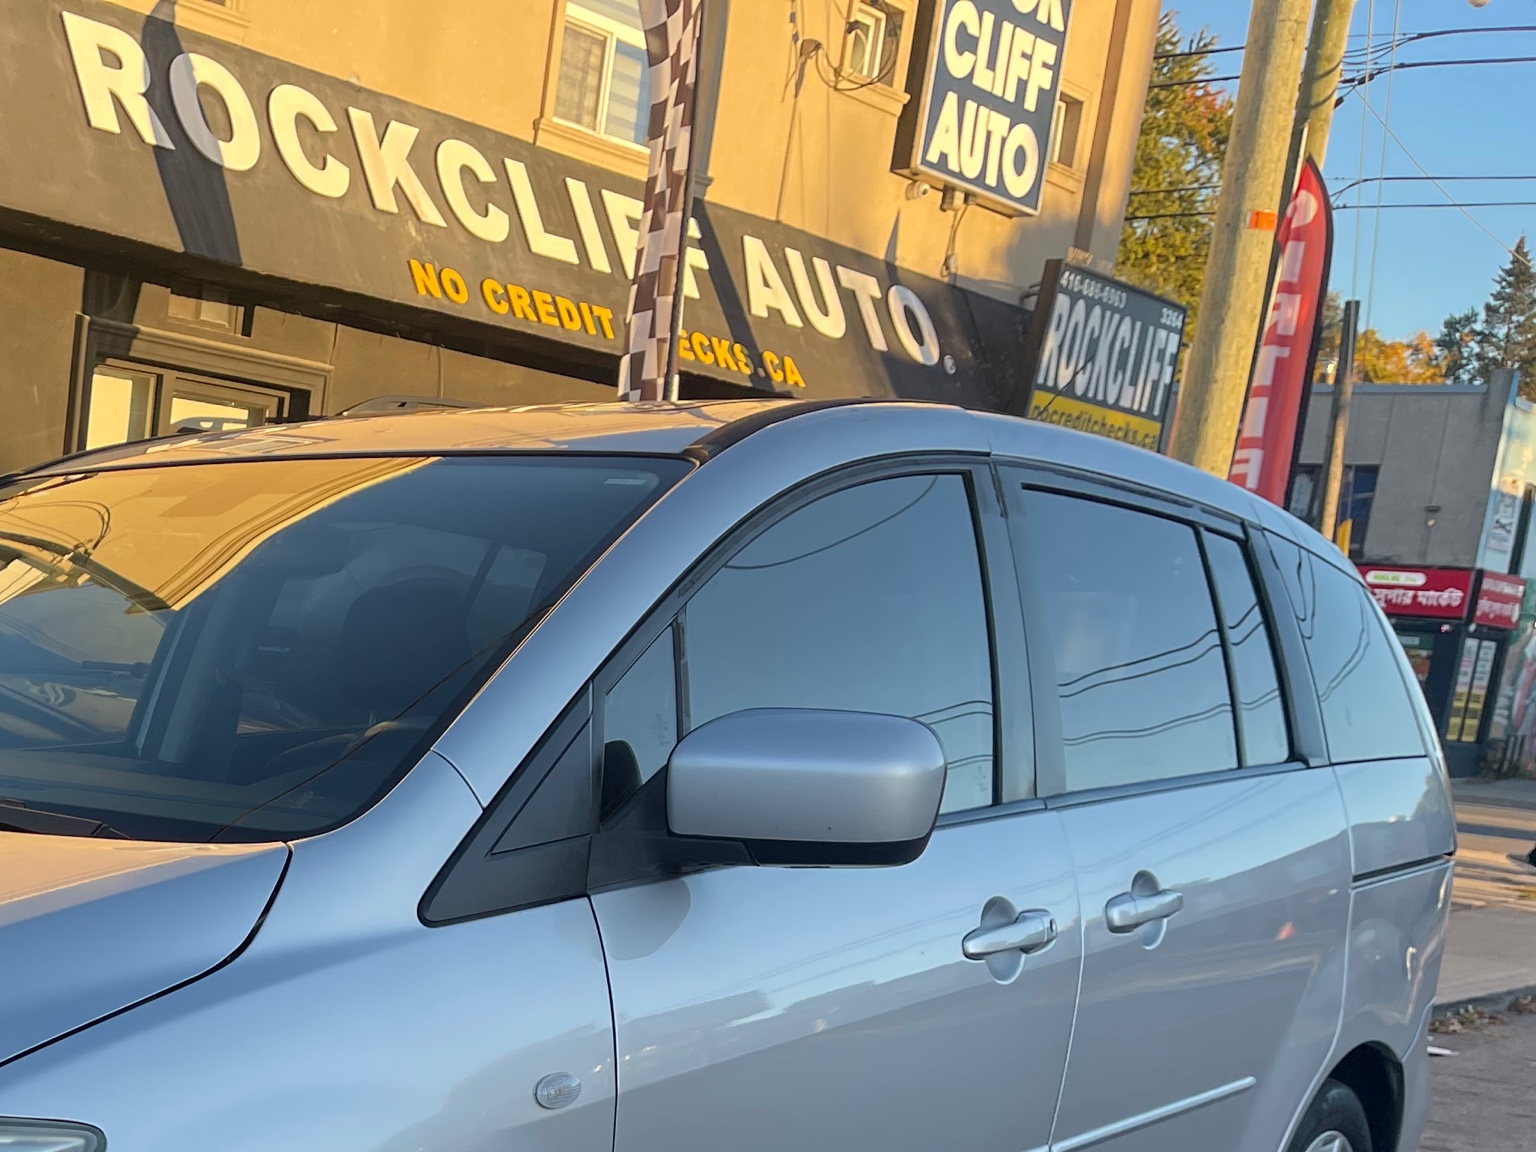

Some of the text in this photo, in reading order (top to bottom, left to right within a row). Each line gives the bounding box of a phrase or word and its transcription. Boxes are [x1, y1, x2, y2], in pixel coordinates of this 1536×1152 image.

[944, 0, 1058, 112] CLIFF
[61, 10, 710, 300] ROCKCLIFF
[925, 91, 1039, 198] AUTO
[408, 258, 469, 305] NO
[481, 278, 614, 340] CREDIT
[1037, 292, 1181, 417] ROCKCLIFF
